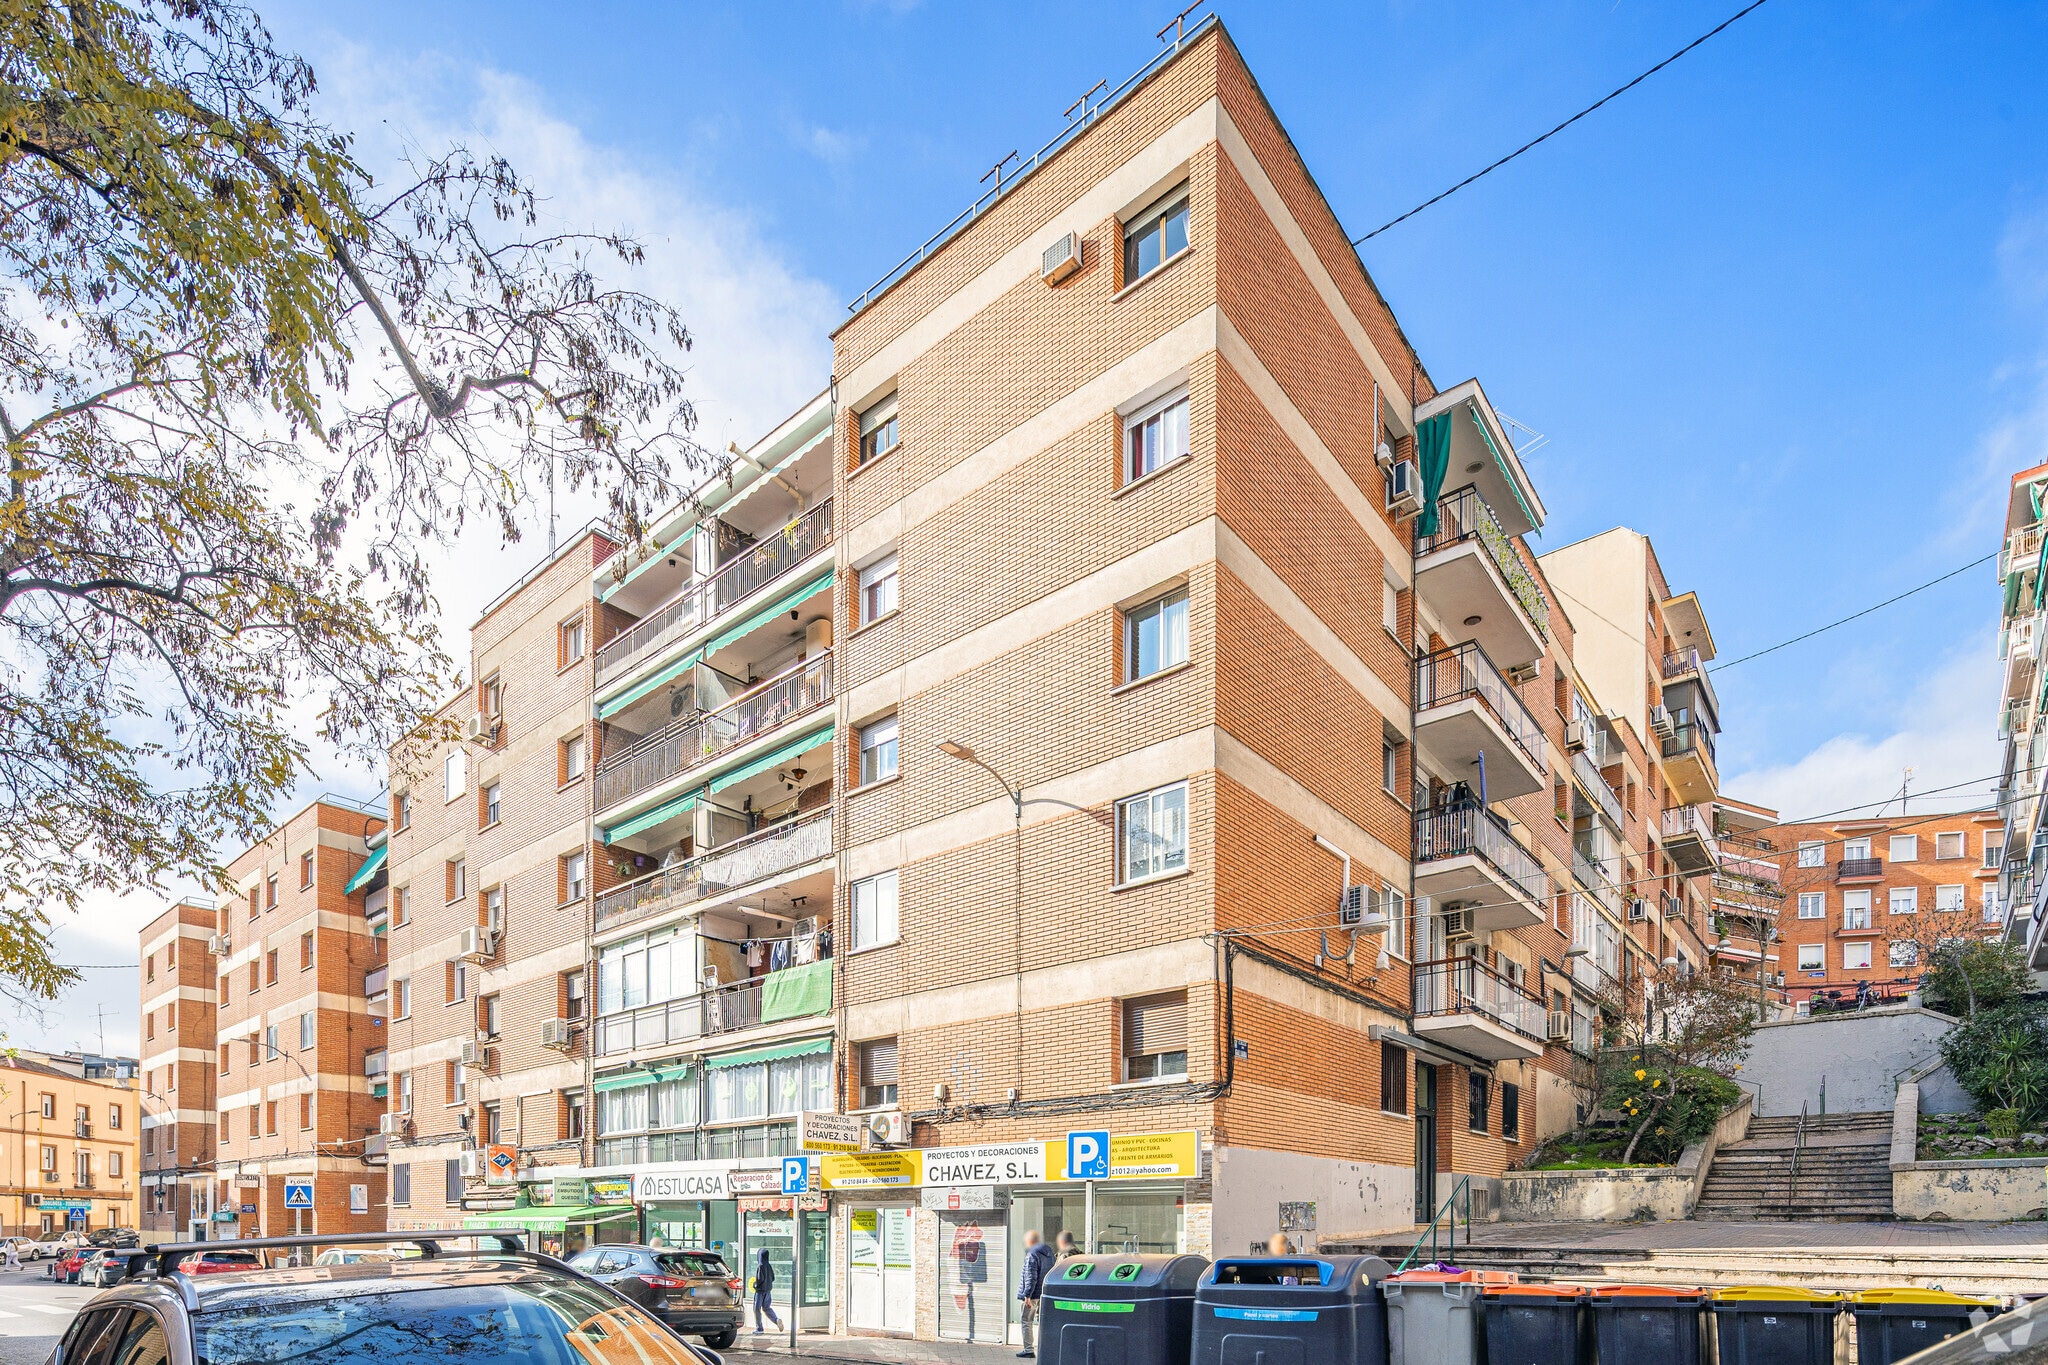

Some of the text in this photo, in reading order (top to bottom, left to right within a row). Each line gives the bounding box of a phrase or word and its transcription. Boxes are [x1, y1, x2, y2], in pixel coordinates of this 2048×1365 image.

[814, 1114, 850, 1124] PROYECTOS
[812, 1122, 858, 1132] DECORACIONES
[806, 1130, 858, 1142] CHAVEZ, S.L.
[927, 1150, 970, 1160] PROYECTOS
[978, 1146, 1039, 1157] DECORACIONES
[1073, 1136, 1099, 1174] P
[785, 1160, 802, 1190] P
[929, 1162, 1038, 1182] CHAVEZ, S.L.
[1112, 1166, 1172, 1175] z1012@yahoo.com
[658, 1176, 722, 1196] ESTUCASA
[780, 1199, 789, 1209] DE
